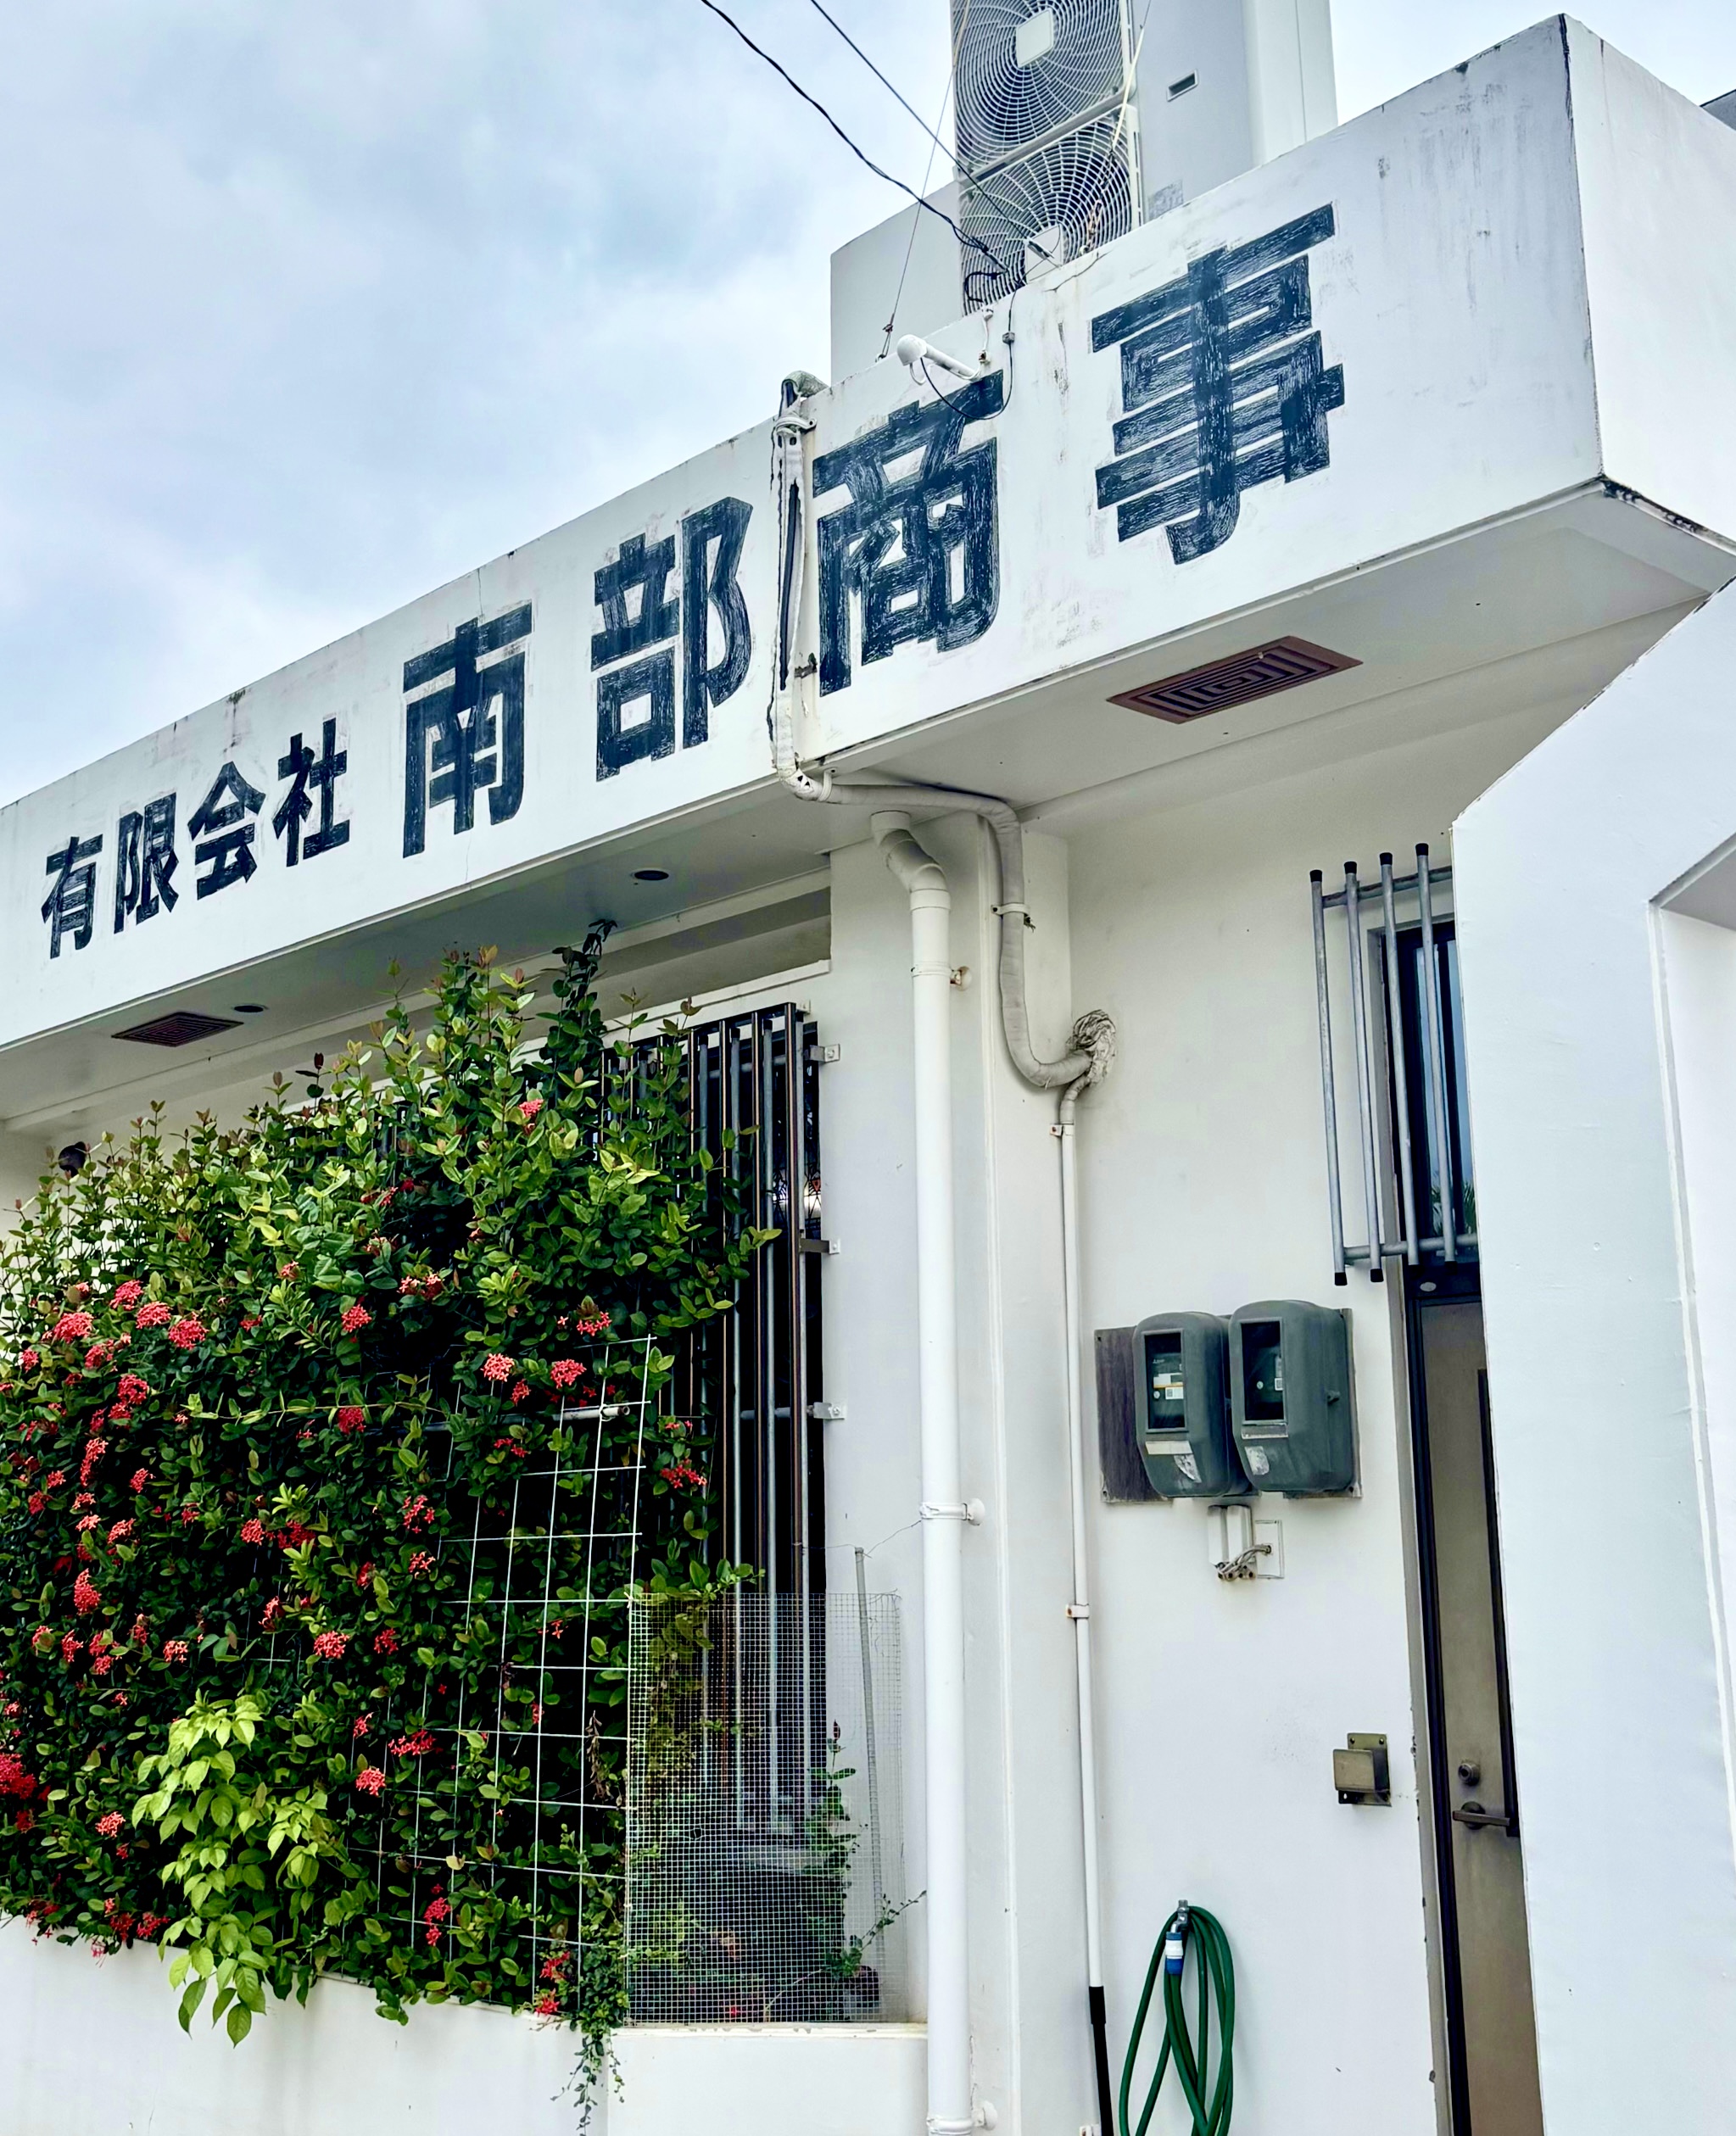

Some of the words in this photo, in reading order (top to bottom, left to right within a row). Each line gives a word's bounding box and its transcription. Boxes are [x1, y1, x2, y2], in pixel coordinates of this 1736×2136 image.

[42, 719, 349, 958] 有限会社
[404, 204, 1344, 858] 南部商事
